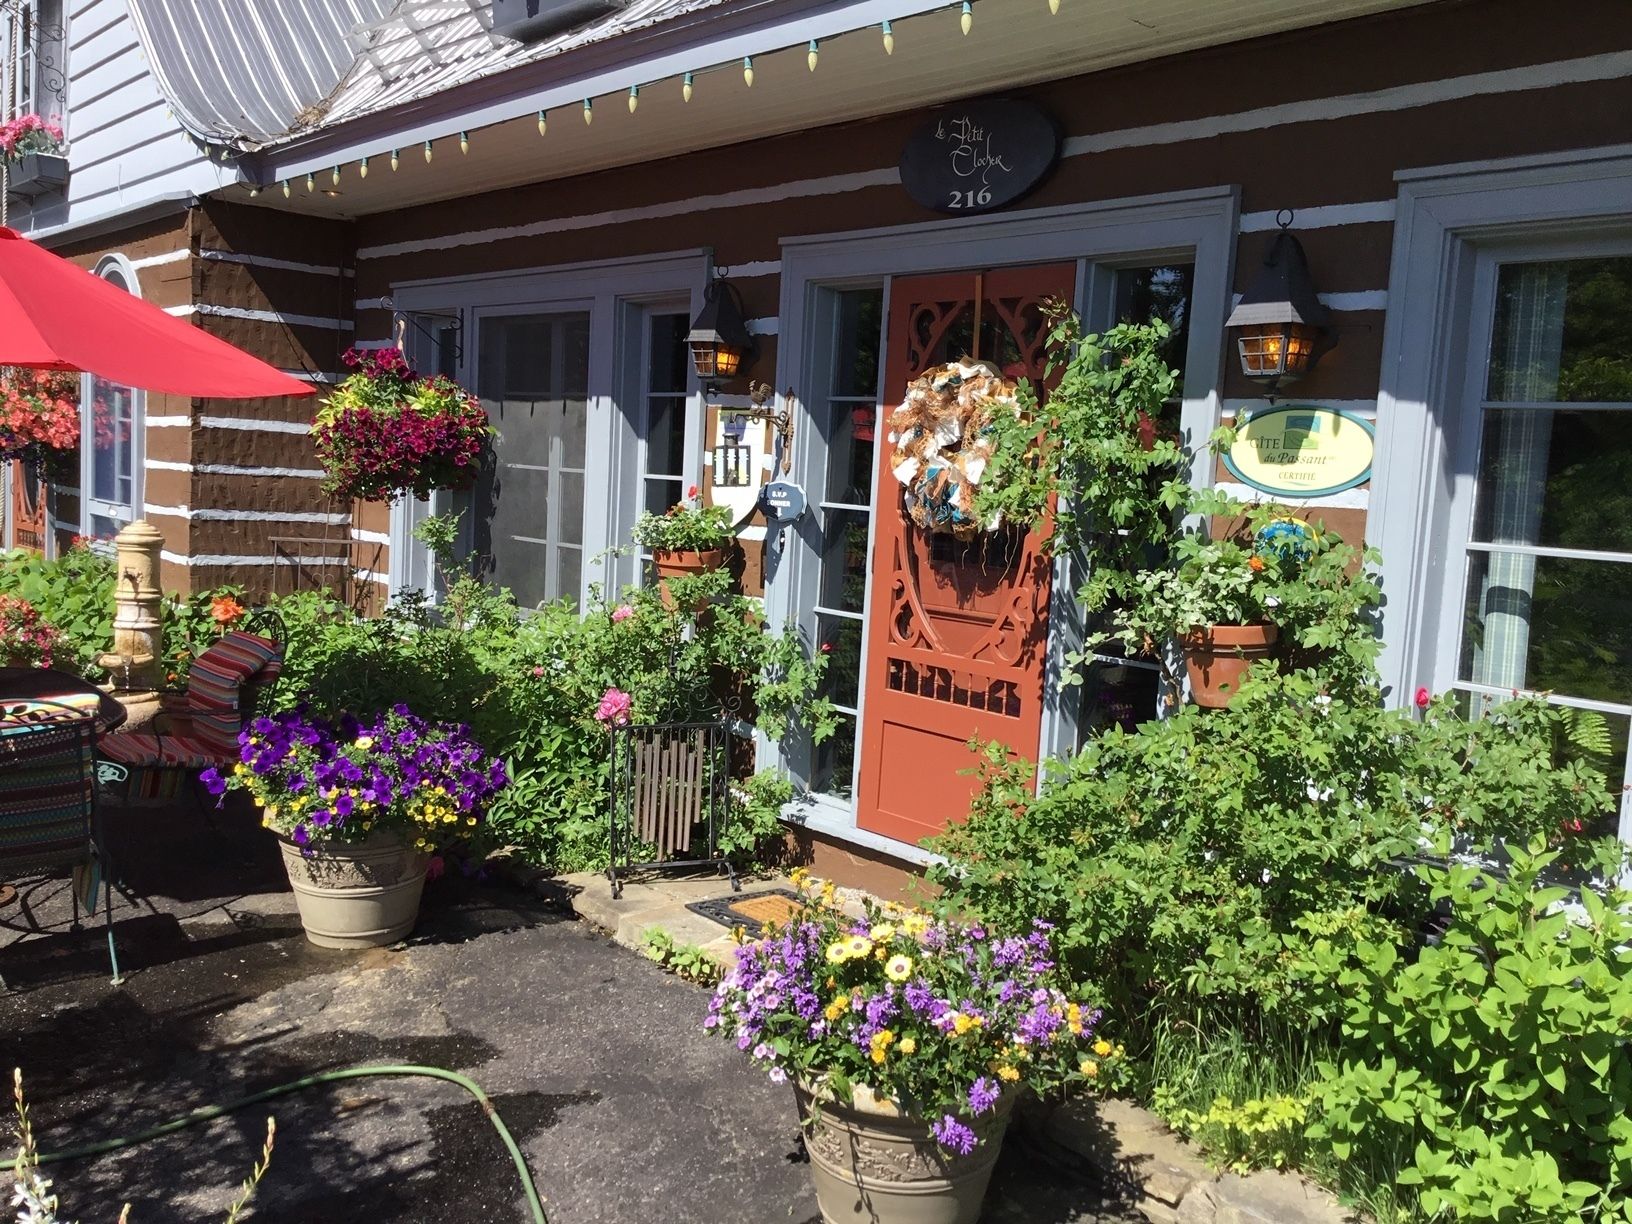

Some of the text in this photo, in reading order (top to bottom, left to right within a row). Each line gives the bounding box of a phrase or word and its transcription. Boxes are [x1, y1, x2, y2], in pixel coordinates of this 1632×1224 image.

[934, 115, 984, 144] Le Petit
[947, 184, 992, 209] 216
[1249, 435, 1281, 450] GÎTE
[1263, 452, 1276, 464] du
[1277, 452, 1327, 465] Passant
[1278, 471, 1316, 481] CERTIFIÉ
